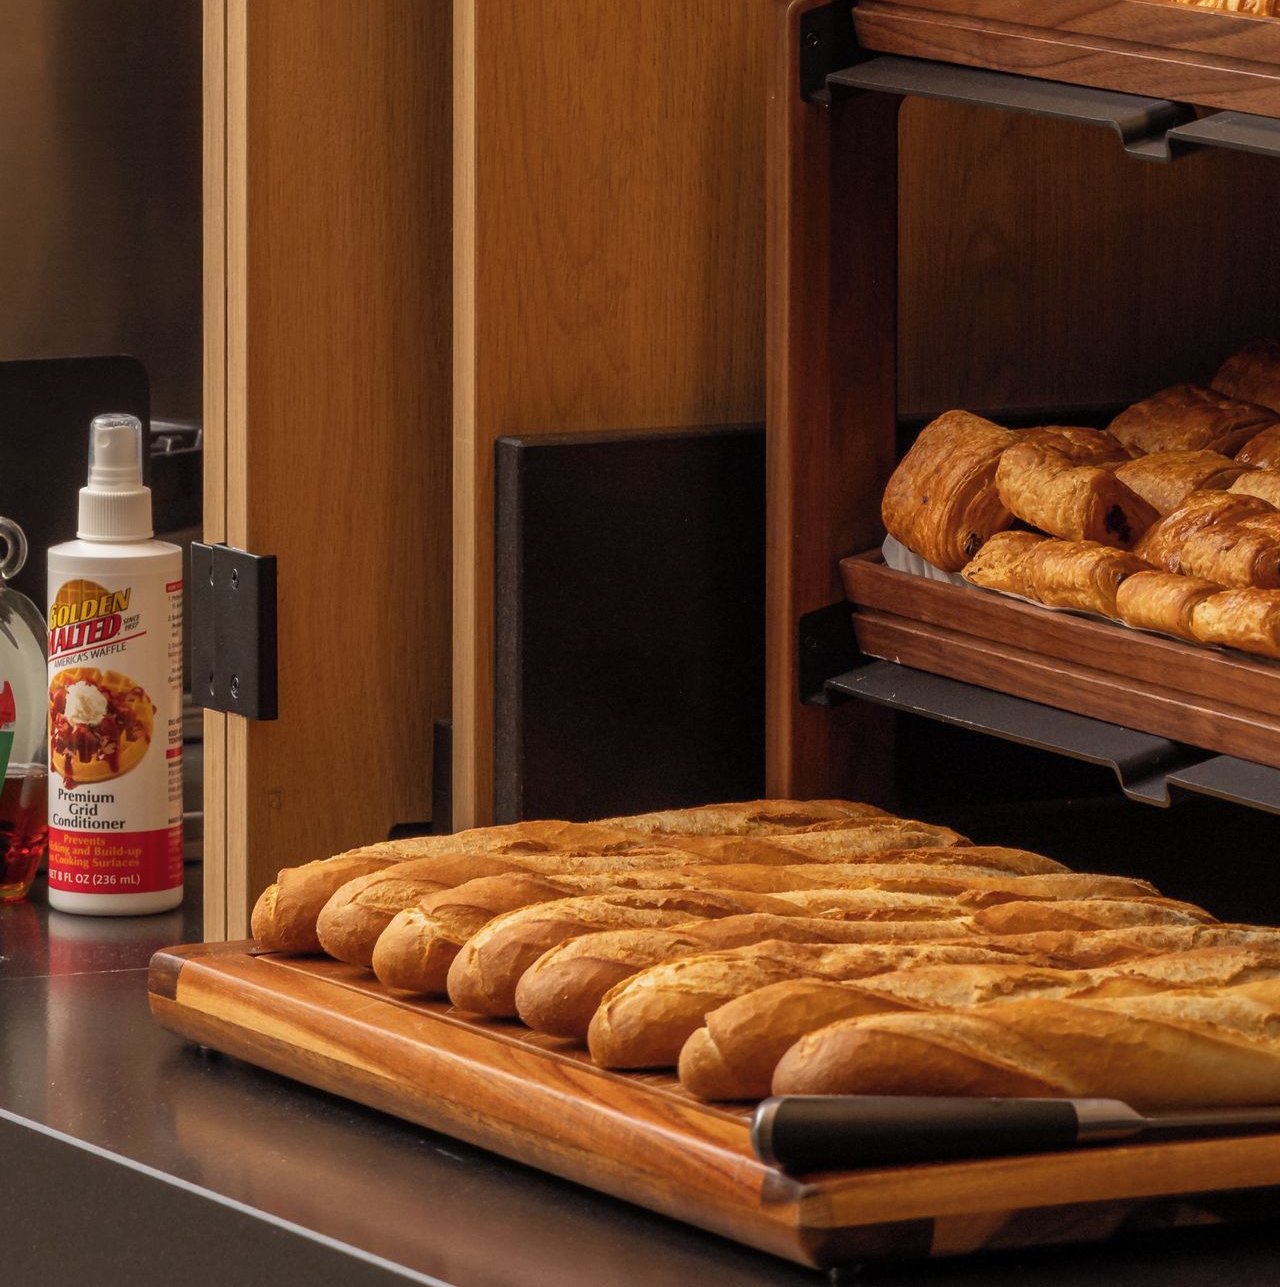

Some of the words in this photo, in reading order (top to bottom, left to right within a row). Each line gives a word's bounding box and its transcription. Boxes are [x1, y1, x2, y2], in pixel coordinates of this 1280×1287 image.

[49, 587, 131, 631] GOLDEN
[123, 613, 141, 625] SINCE
[54, 651, 89, 668] AMERICA'S
[90, 642, 127, 659] WAFFLE
[58, 788, 115, 804] Premium
[68, 803, 98, 816] Grid
[52, 813, 126, 830] Conditioner
[63, 834, 106, 846] Prevents
[72, 846, 91, 856] and
[94, 846, 142, 858] Build-up
[54, 853, 90, 870] Cooking
[92, 857, 140, 868] Surfaces
[57, 871, 63, 882] 8
[63, 872, 74, 883] FL
[75, 873, 90, 884] OZ
[92, 873, 117, 886] (236
[119, 873, 141, 886] mL)
